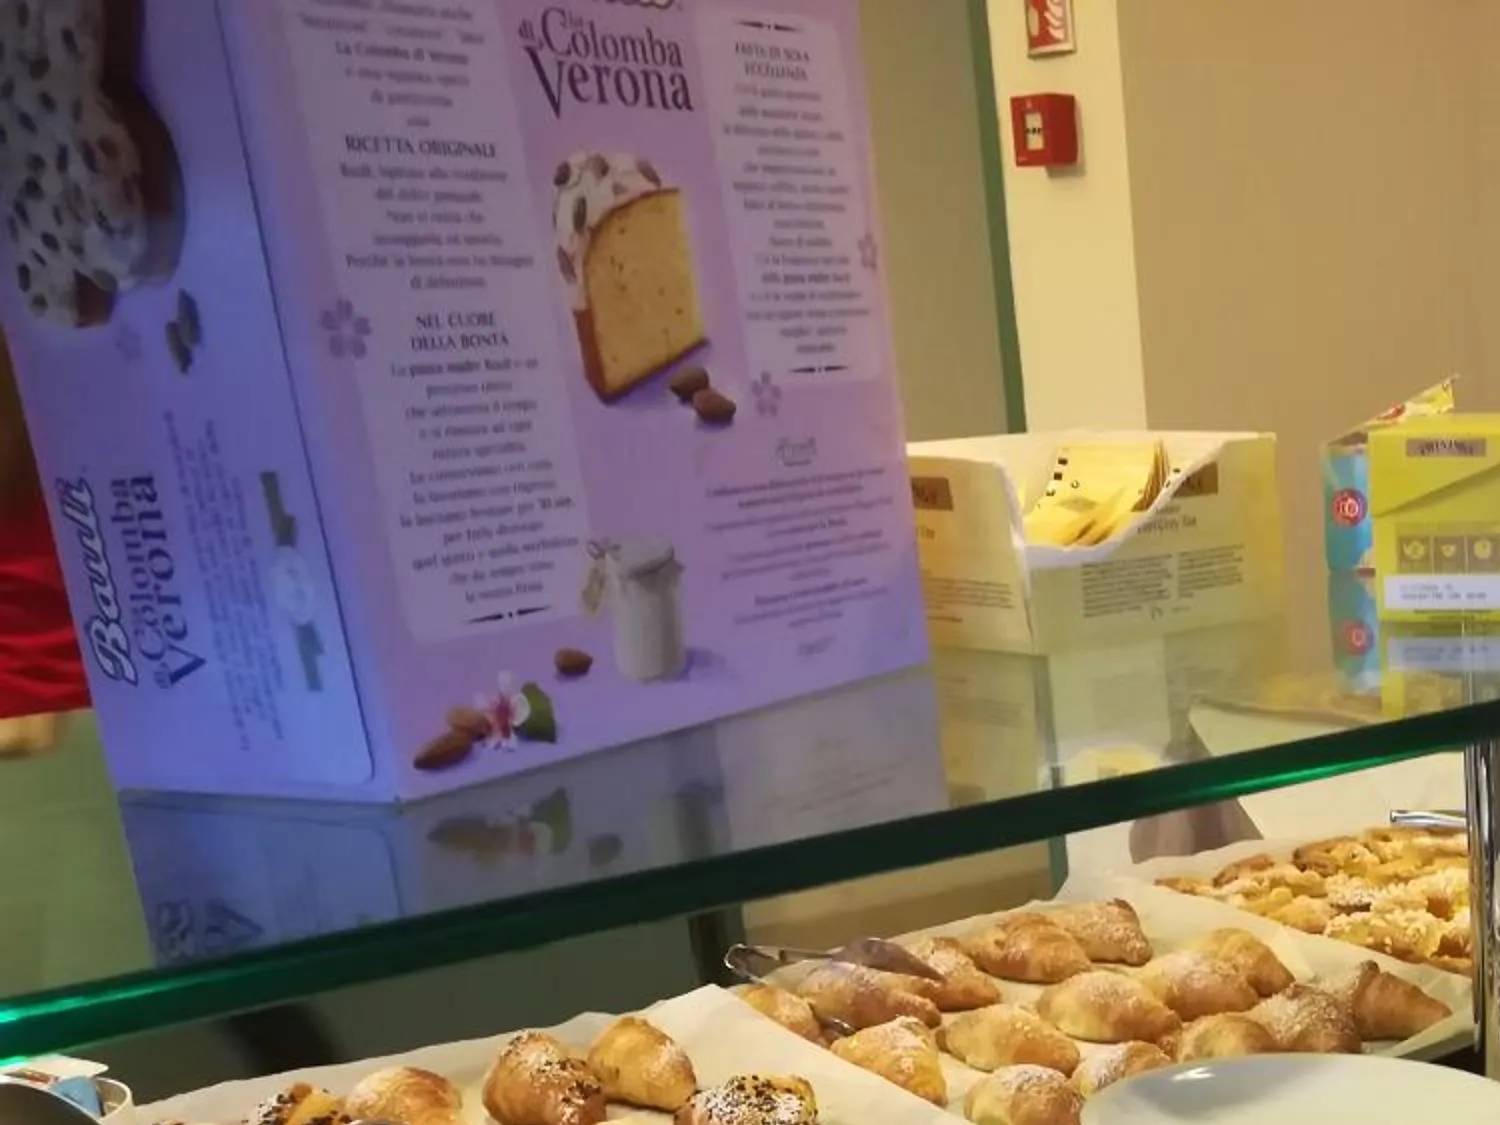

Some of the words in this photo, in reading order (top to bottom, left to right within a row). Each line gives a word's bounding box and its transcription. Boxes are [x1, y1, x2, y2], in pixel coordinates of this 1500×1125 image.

[521, 44, 695, 120] Verona
[540, 6, 684, 68] Colomba
[109, 477, 167, 662] Colomba
[130, 471, 208, 686] Verona
